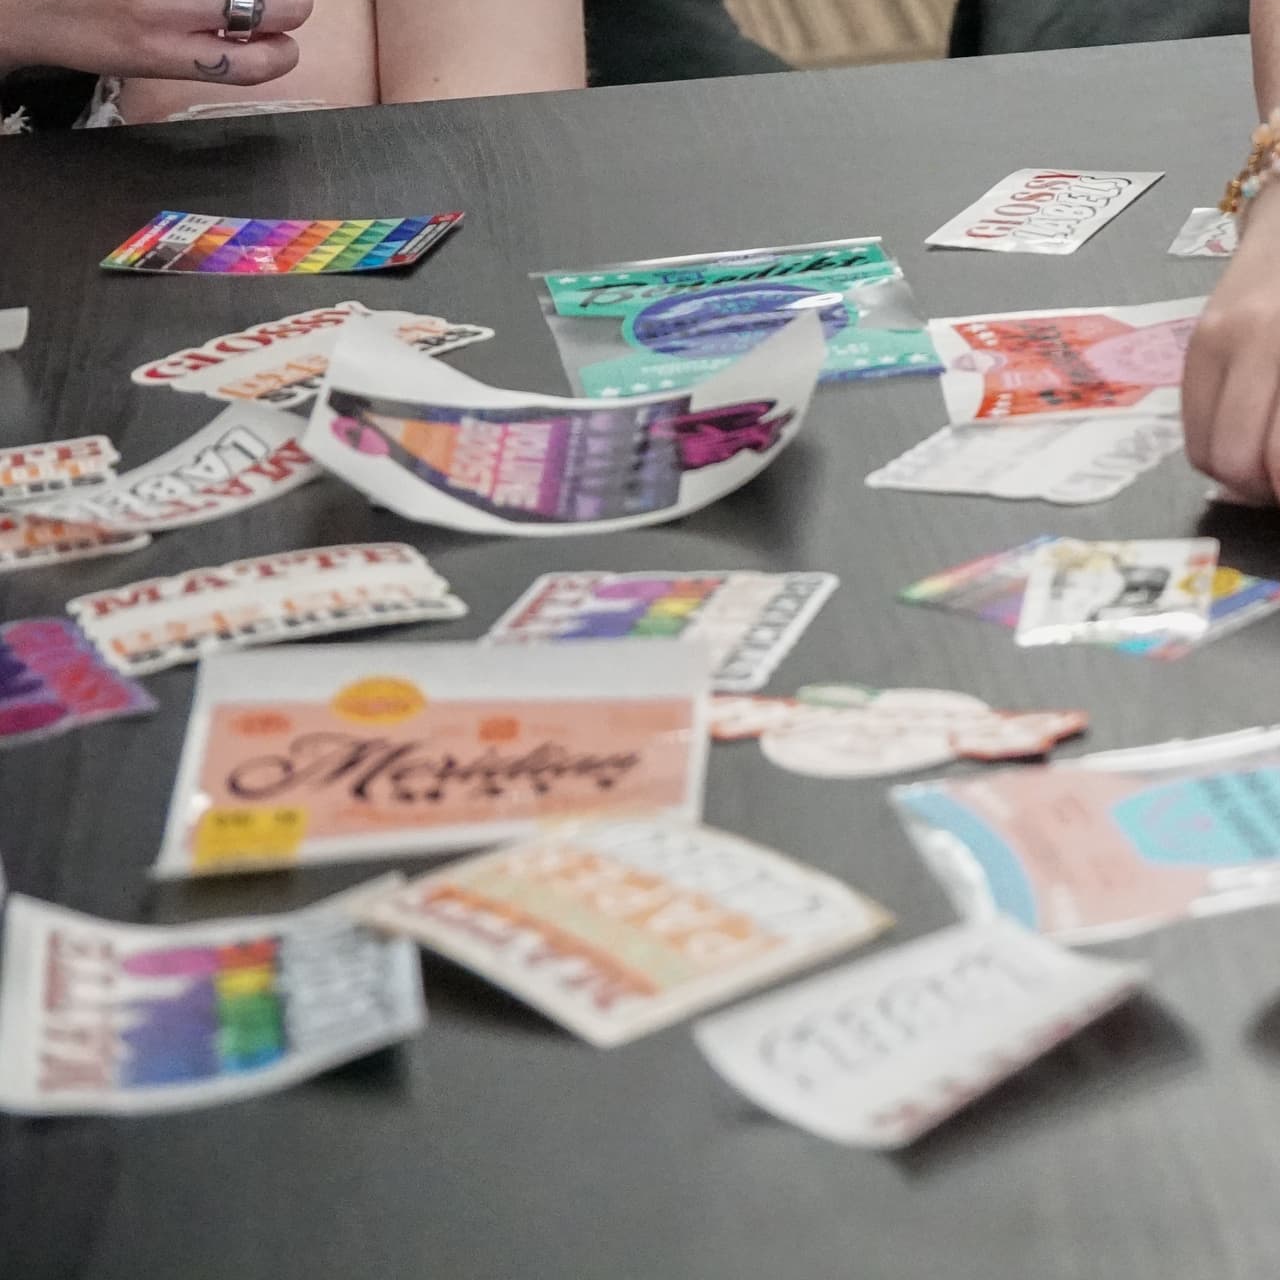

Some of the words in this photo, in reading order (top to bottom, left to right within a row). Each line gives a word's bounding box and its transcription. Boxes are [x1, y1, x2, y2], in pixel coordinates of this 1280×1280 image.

[964, 171, 1080, 239] GLOSSY
[1011, 175, 1132, 246] LABELS
[89, 542, 415, 616] MATTE
